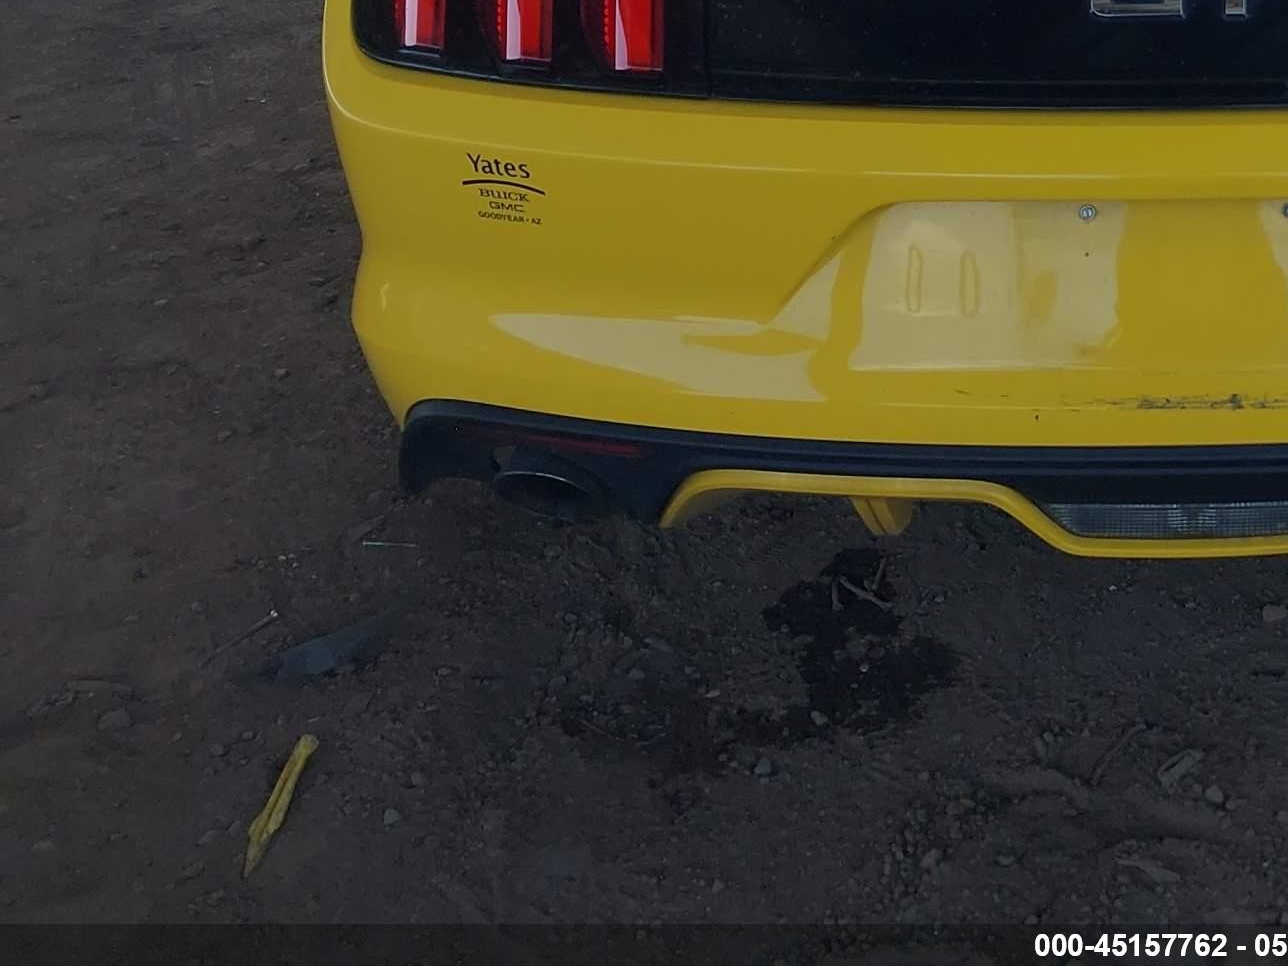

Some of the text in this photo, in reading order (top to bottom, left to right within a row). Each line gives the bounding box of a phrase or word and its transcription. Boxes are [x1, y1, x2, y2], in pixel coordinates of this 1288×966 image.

[466, 152, 530, 179] Yates
[479, 188, 530, 202] BUICK
[489, 201, 525, 213] GMC
[478, 210, 525, 223] GOODYEAR
[531, 217, 542, 225] AZ
